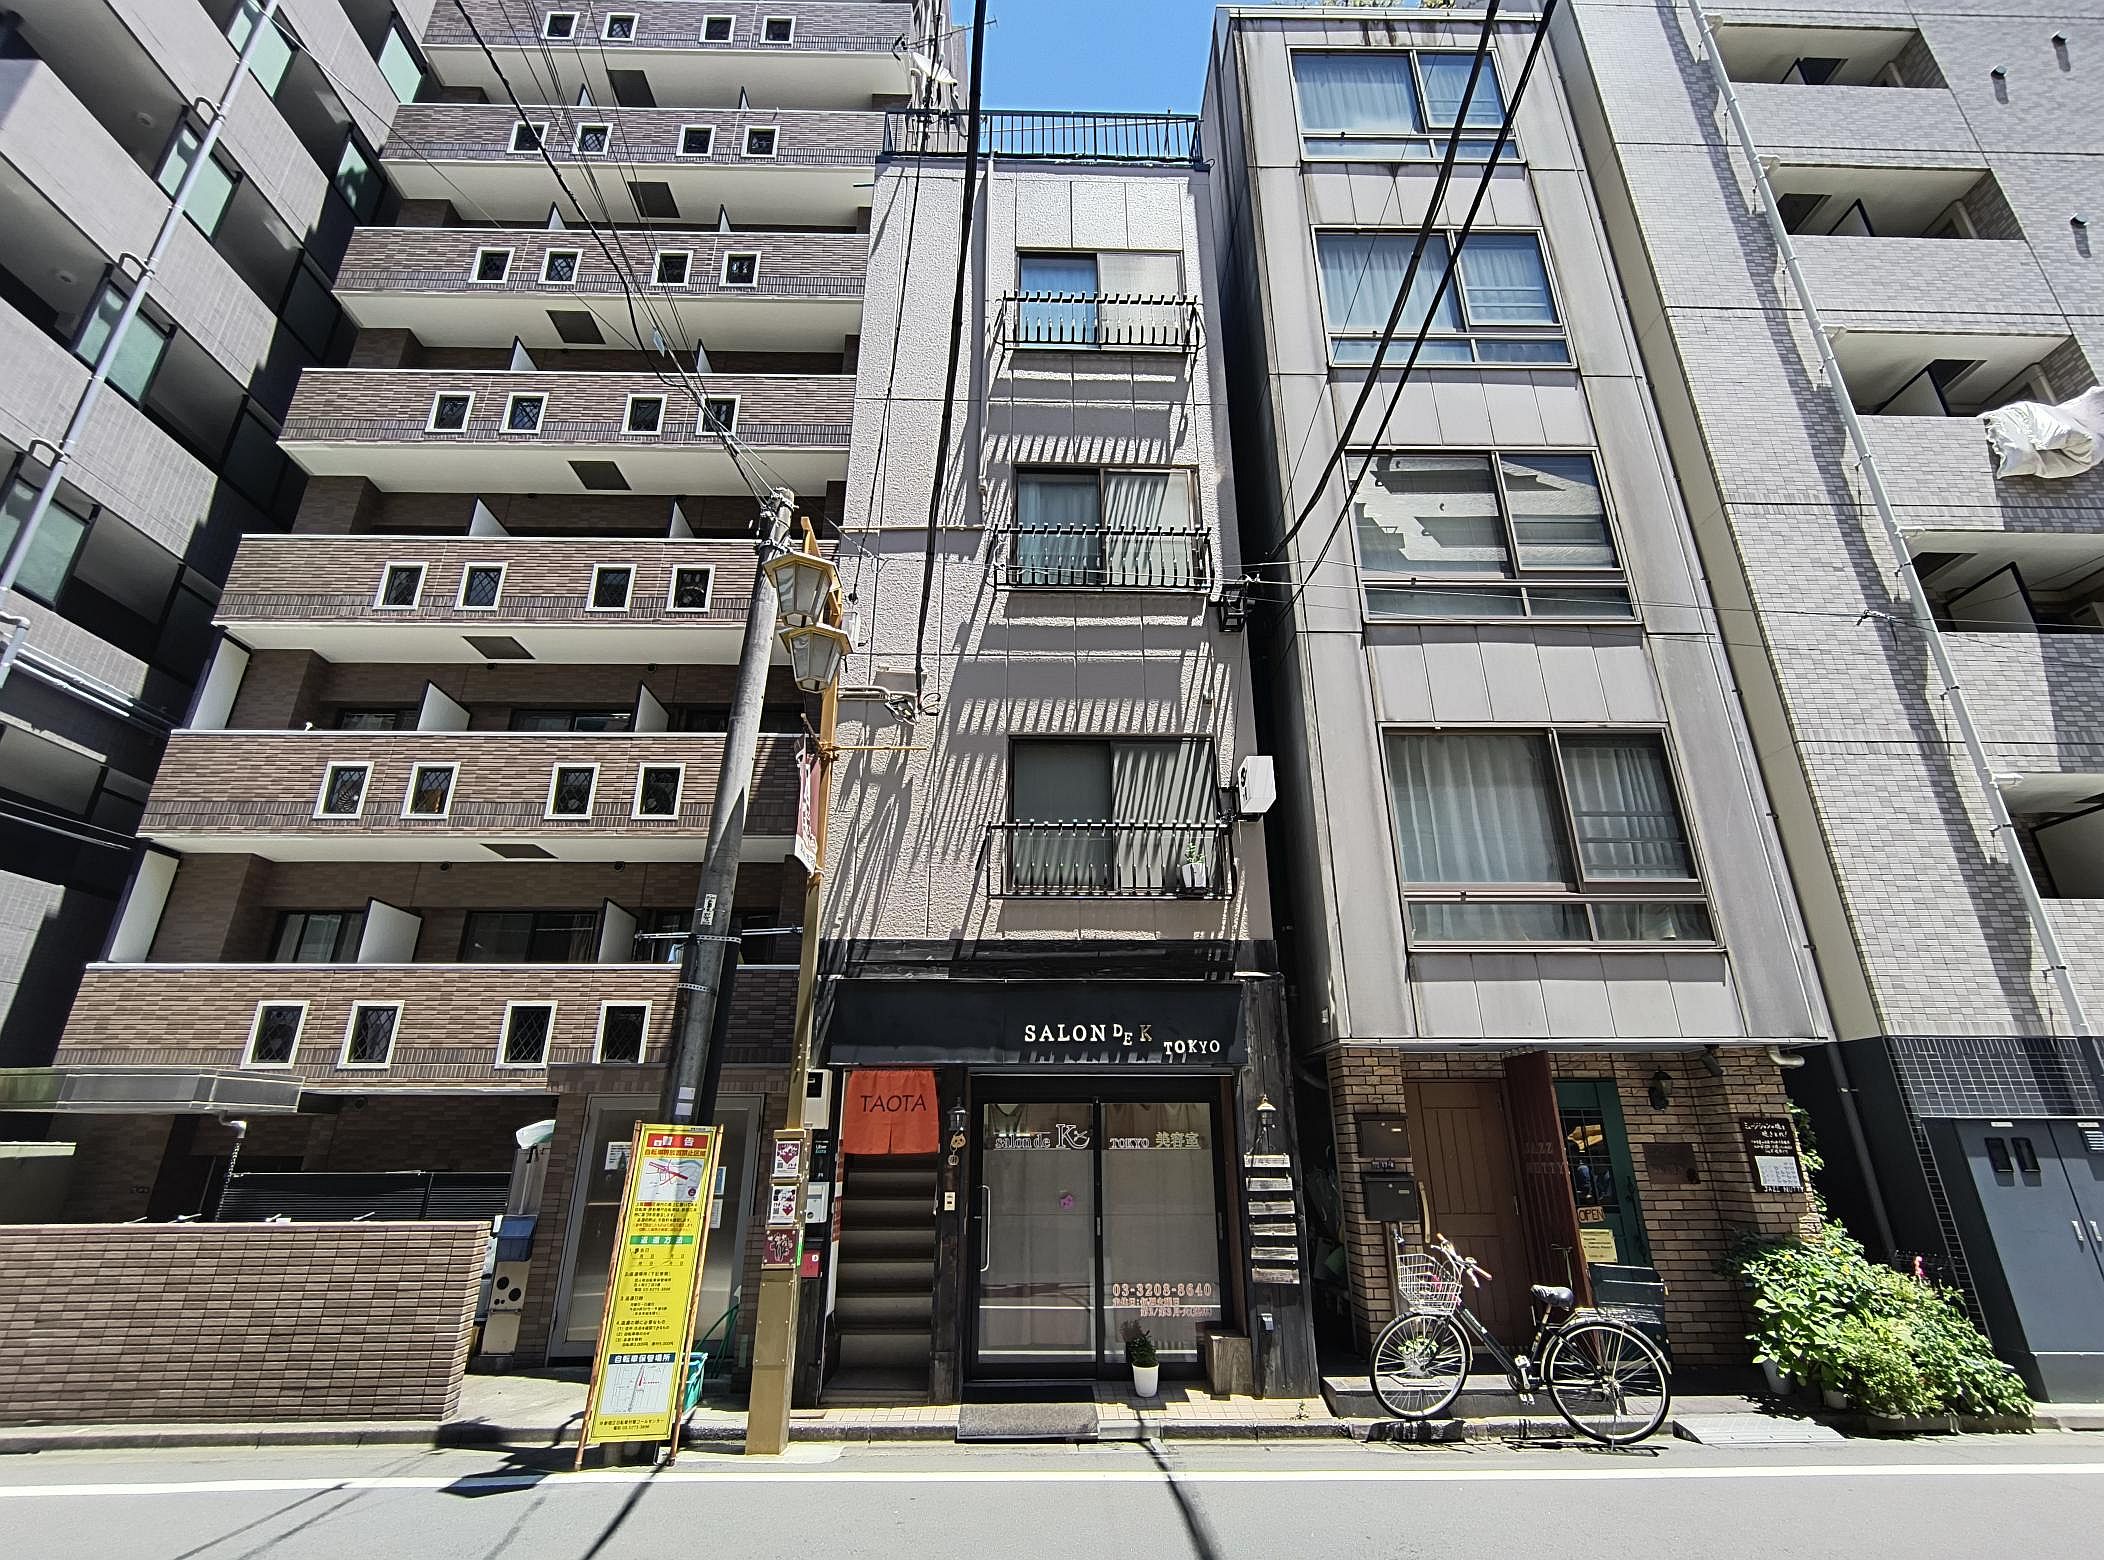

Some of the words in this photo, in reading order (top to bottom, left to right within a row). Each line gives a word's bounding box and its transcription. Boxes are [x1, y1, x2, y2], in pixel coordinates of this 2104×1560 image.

[1024, 1023, 1106, 1042] SALON
[1113, 1023, 1133, 1046] DE
[1139, 1024, 1153, 1042] K
[1163, 1039, 1220, 1056] TOKYO
[860, 1094, 927, 1113] TAOTA
[994, 1134, 1033, 1149] salon
[1034, 1133, 1051, 1149] de
[1110, 1137, 1150, 1149] TOKYO
[1155, 1131, 1200, 1148] 美容室
[1578, 1208, 1605, 1221] OPEN
[1112, 1283, 1212, 1297] 03-3208-8640
